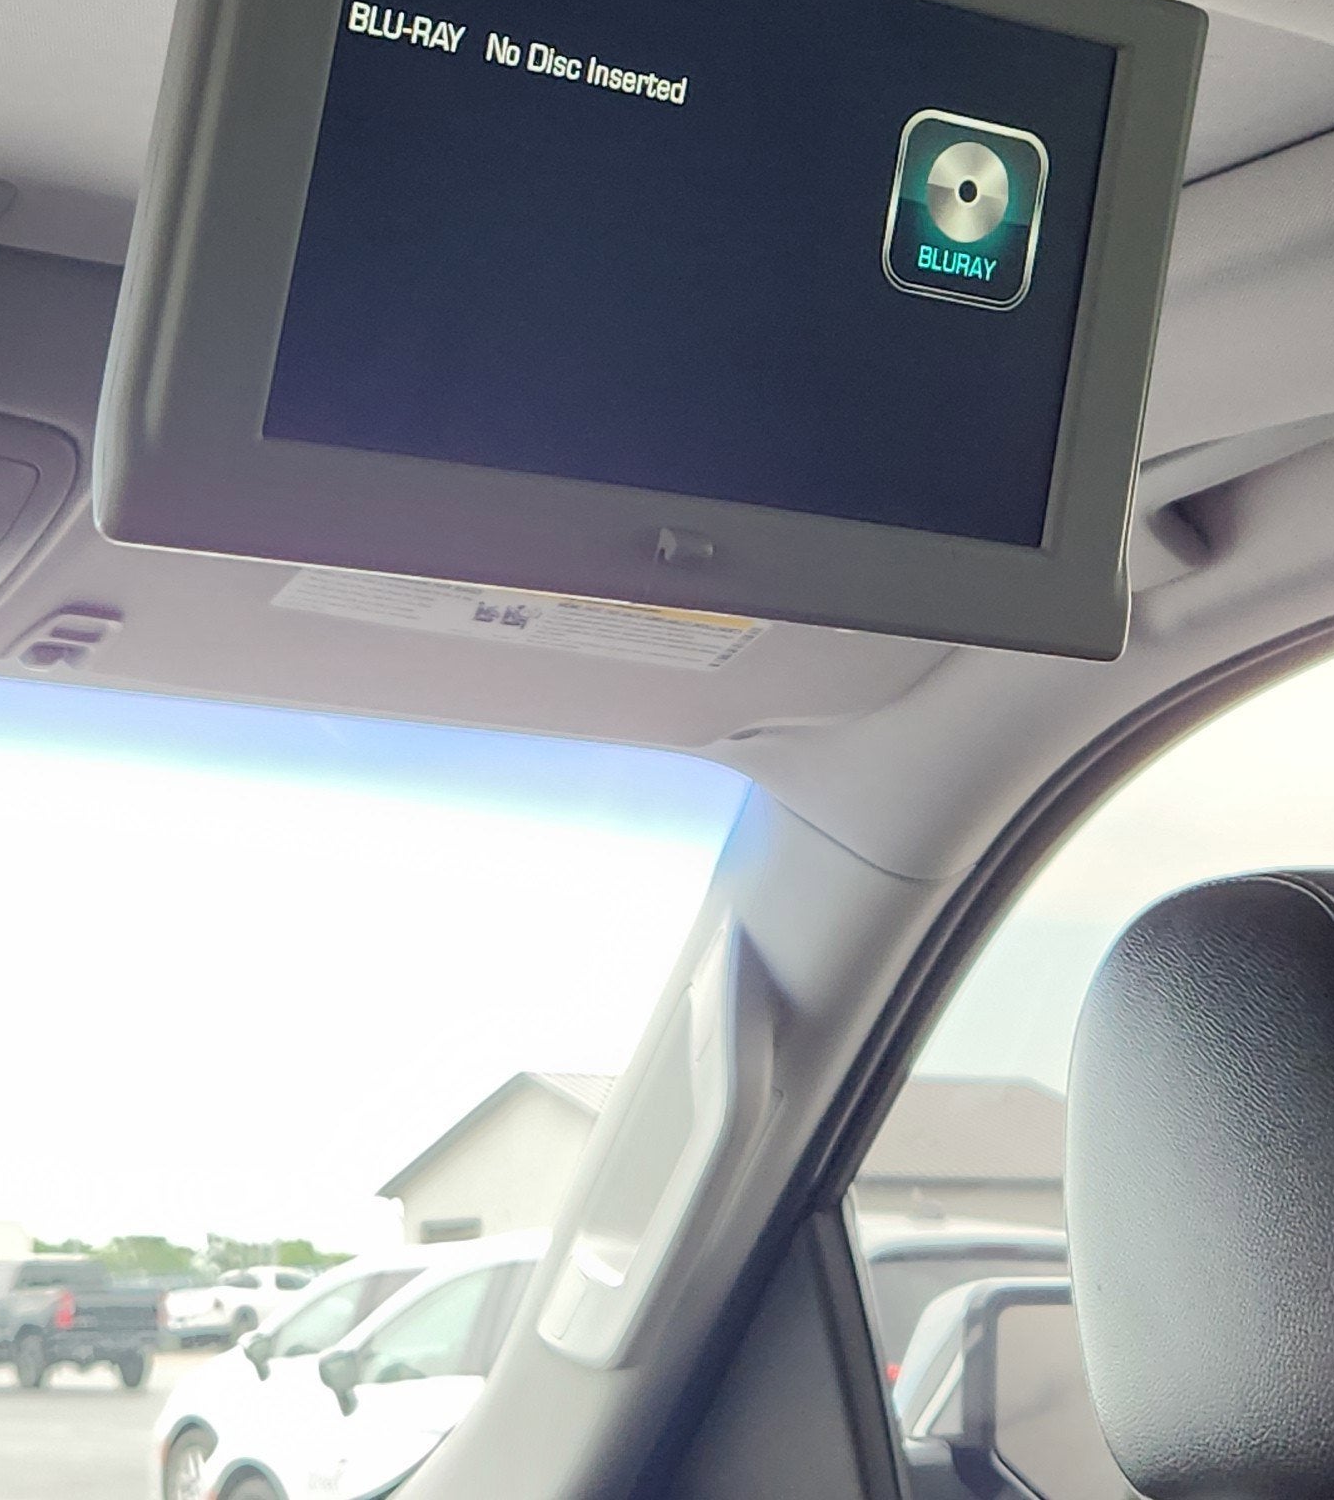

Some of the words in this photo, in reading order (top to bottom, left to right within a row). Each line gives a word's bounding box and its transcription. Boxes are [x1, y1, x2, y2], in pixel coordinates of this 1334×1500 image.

[347, 0, 467, 53] BLU-RAY
[484, 32, 521, 67] No
[525, 41, 582, 81] Disc
[585, 55, 688, 106] Inserted
[917, 244, 997, 282] BLURAY
